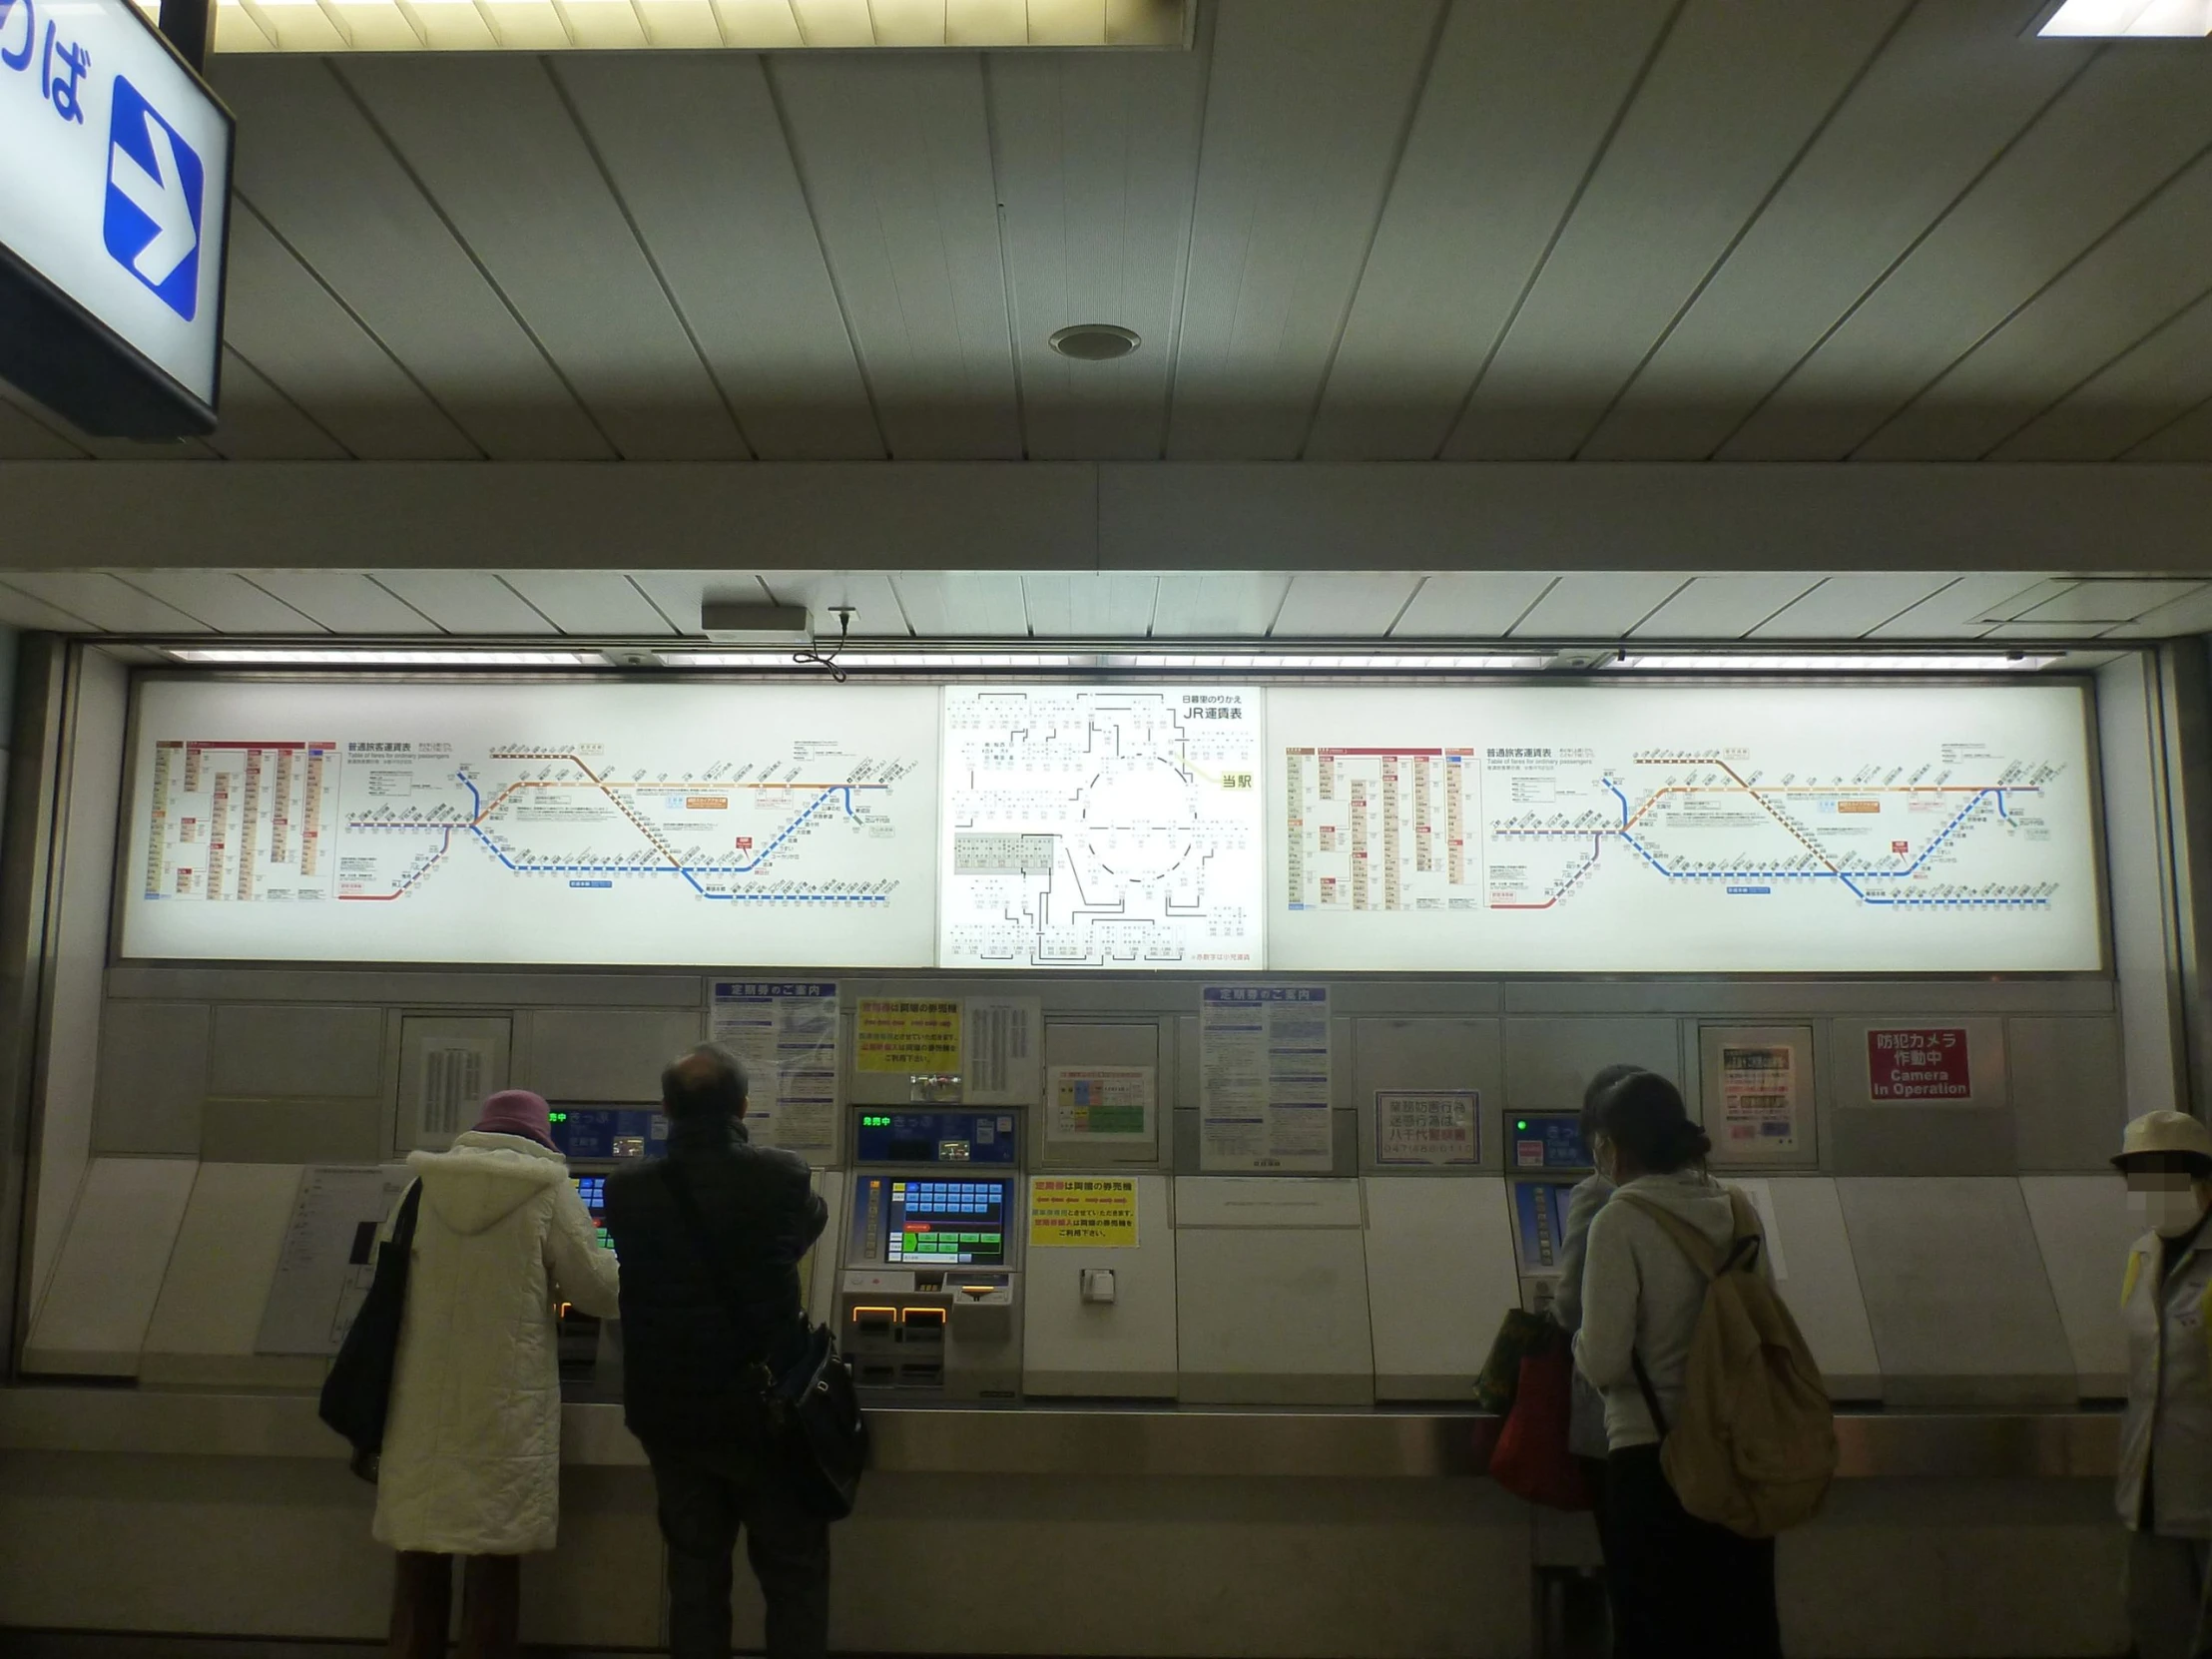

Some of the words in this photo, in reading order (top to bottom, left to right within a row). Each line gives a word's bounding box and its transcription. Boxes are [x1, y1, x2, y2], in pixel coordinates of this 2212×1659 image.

[1182, 695, 1242, 705] 日暮里のりかえ
[1183, 707, 1243, 720] JR運賃表
[1486, 748, 1551, 758] 普通旅客運賃表
[1222, 775, 1253, 789] 当駅
[1220, 988, 1311, 1001] 定期券のご案内
[1877, 1033, 1956, 1049] 防犯カメラ
[1895, 1050, 1942, 1067] 作動中
[1891, 1069, 1949, 1081] Camera
[1874, 1082, 1889, 1095] In
[1893, 1082, 1966, 1097] Operation
[862, 1116, 891, 1127] 発売中
